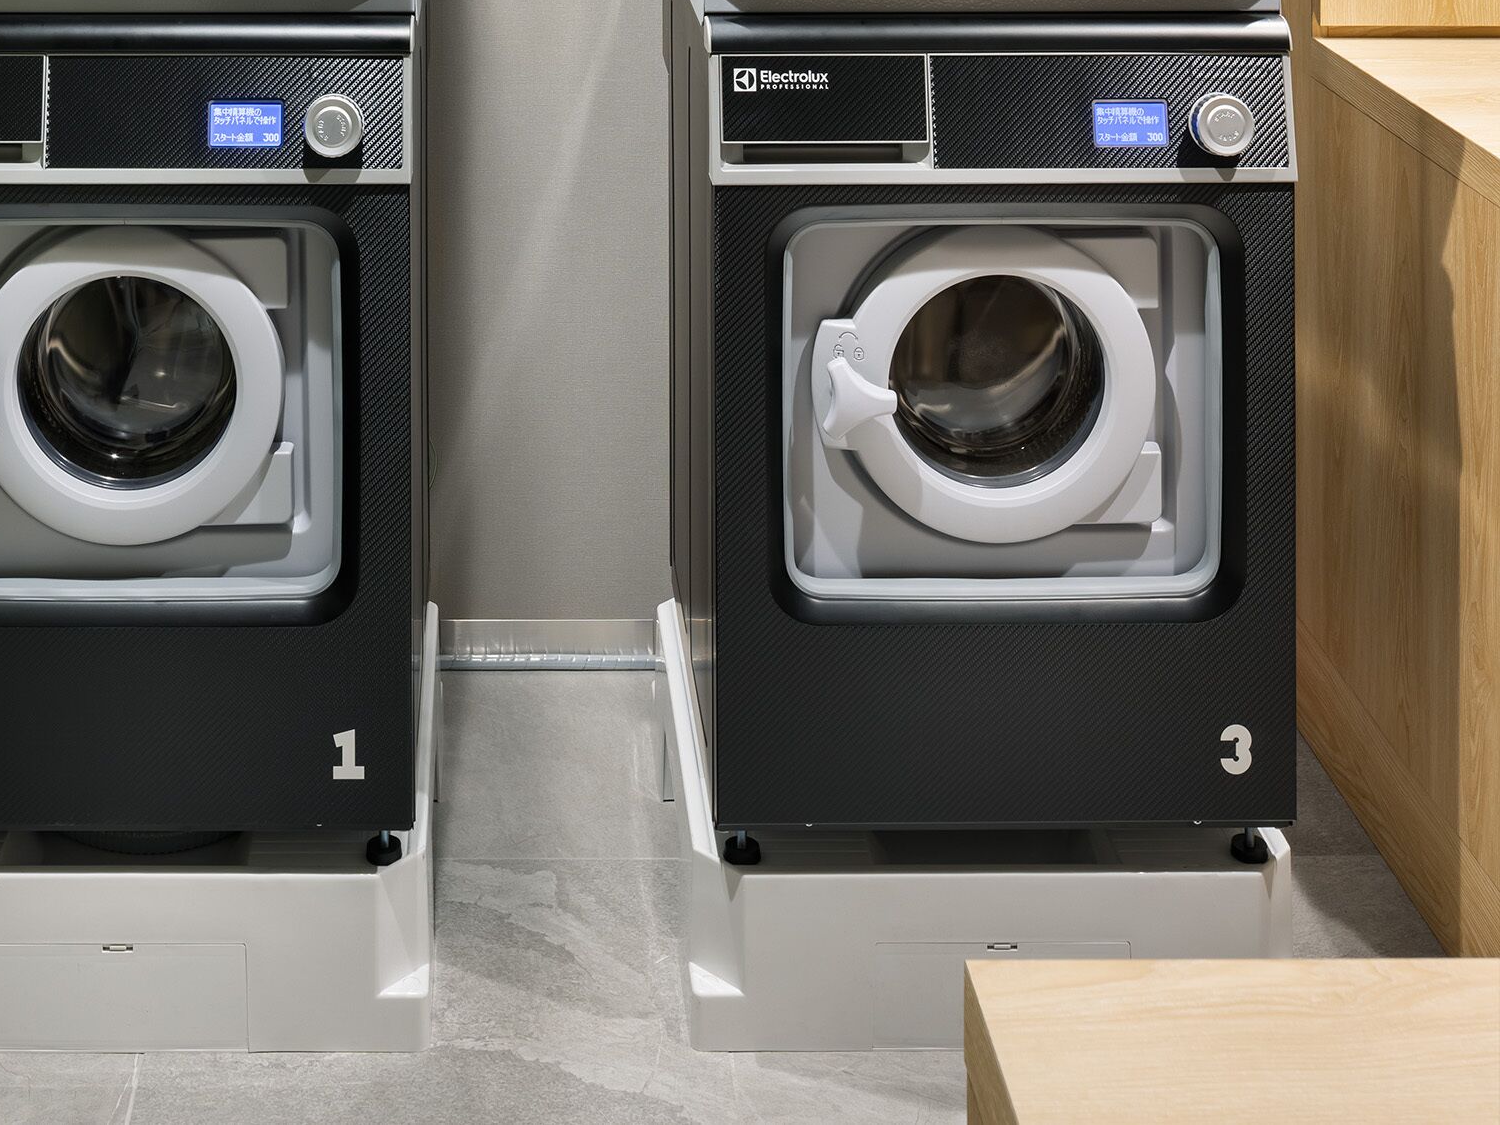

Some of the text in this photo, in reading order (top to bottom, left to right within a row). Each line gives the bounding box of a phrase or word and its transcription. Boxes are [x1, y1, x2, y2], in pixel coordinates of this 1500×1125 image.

[760, 70, 829, 83] Electrolux
[213, 133, 279, 142] スタート金額 300
[1147, 132, 1163, 142] 300
[333, 728, 365, 780] 1
[1220, 724, 1252, 775] 3
